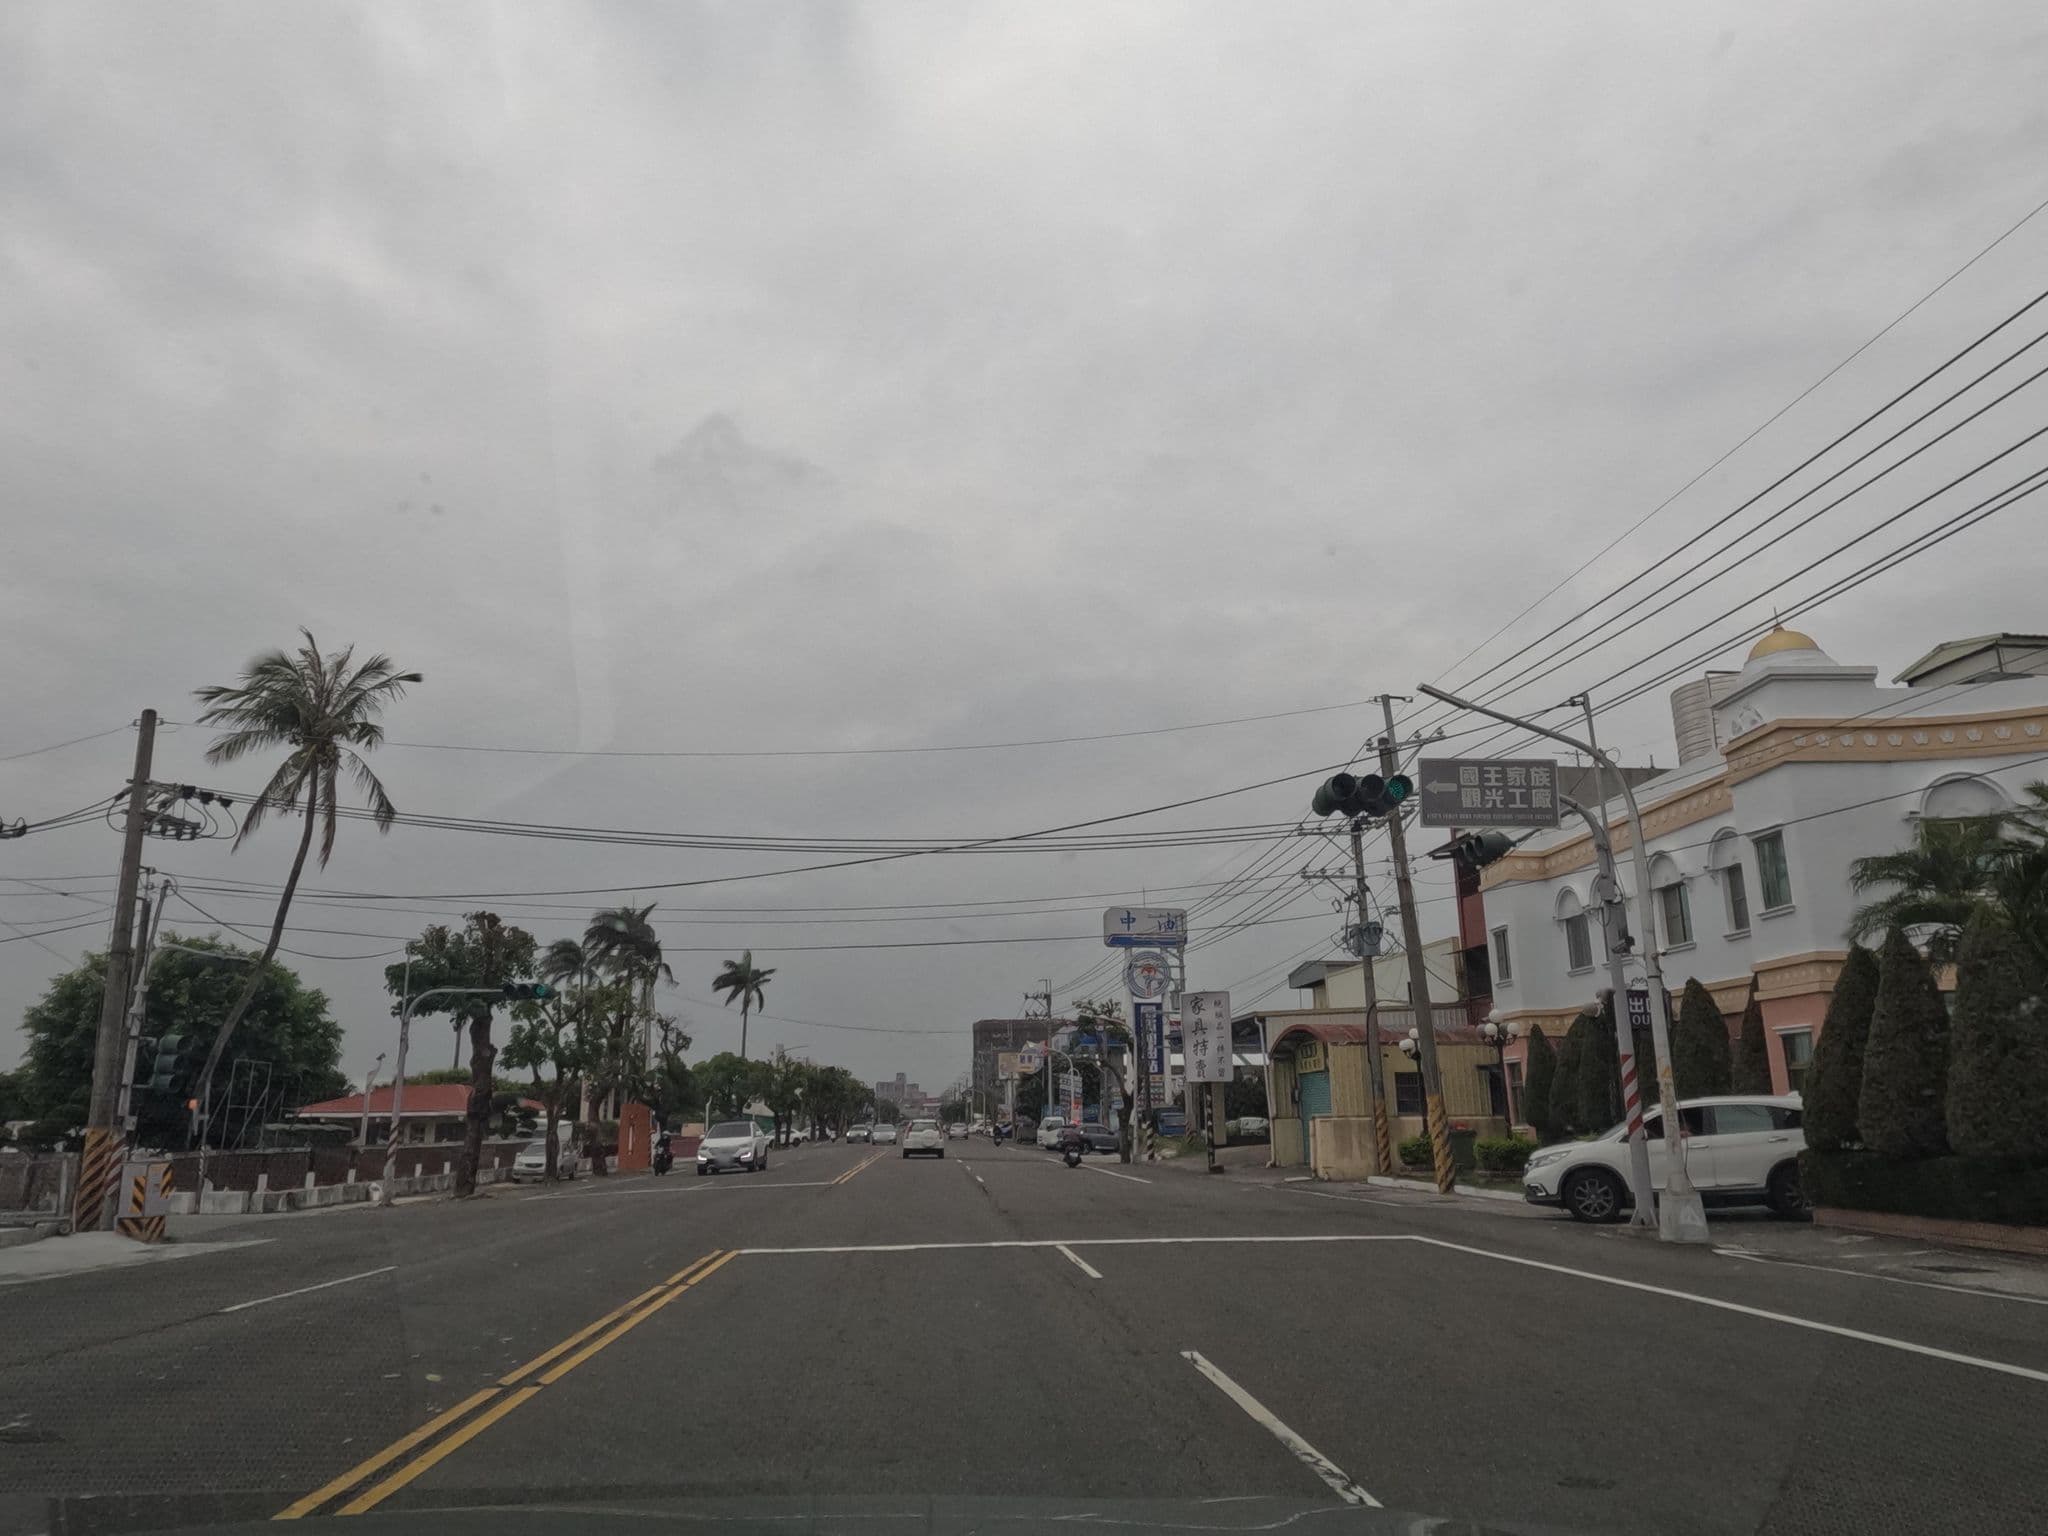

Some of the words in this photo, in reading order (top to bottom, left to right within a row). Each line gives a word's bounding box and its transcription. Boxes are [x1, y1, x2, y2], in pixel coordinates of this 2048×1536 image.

[1459, 766, 1551, 787] 國王家族
[1461, 788, 1553, 808] 觀光工廠
[1120, 910, 1176, 932] 中油
[1629, 997, 1651, 1013] 出
[1632, 1014, 1651, 1025] OU
[1190, 995, 1209, 1079] 家具特賣
